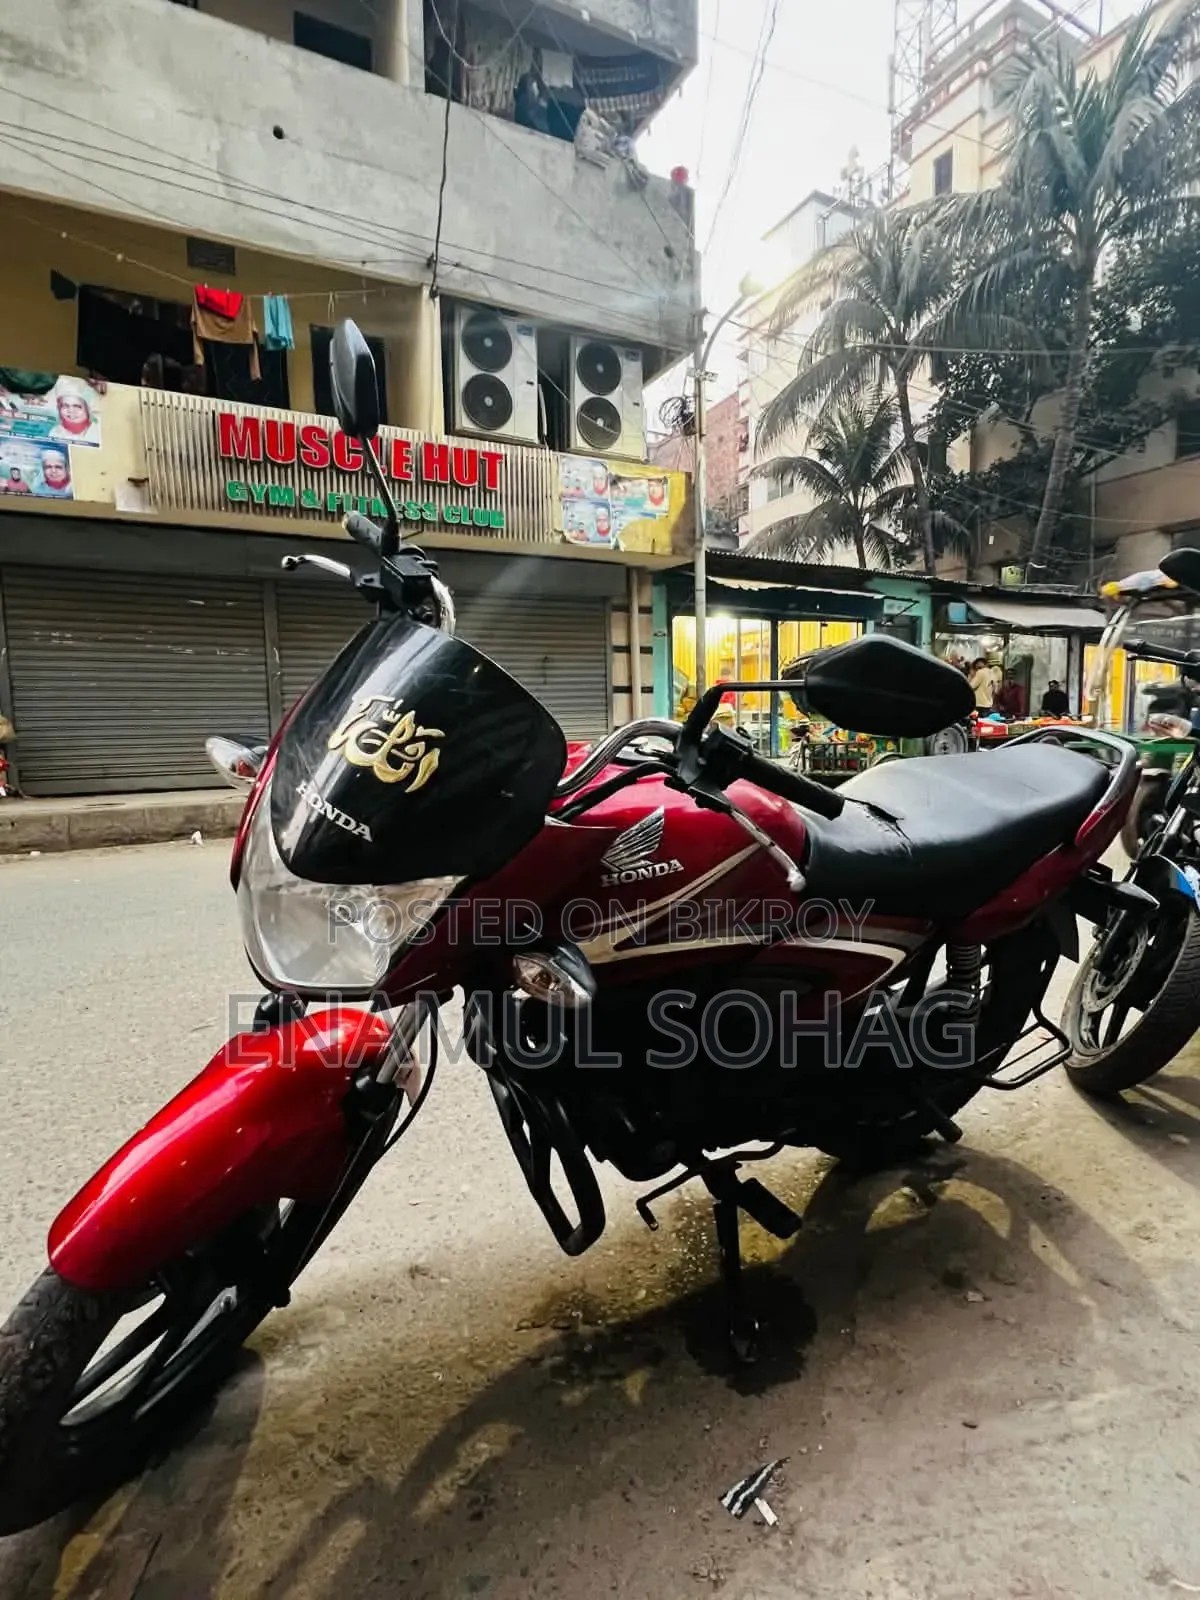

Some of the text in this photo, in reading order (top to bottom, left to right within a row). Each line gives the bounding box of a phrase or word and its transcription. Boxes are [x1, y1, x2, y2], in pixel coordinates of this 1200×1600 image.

[219, 413, 504, 490] MUSCE HUT
[226, 480, 295, 507] GYM
[443, 504, 505, 529] CLUB
[296, 780, 373, 842] HONDA
[600, 858, 685, 888] HONDA
